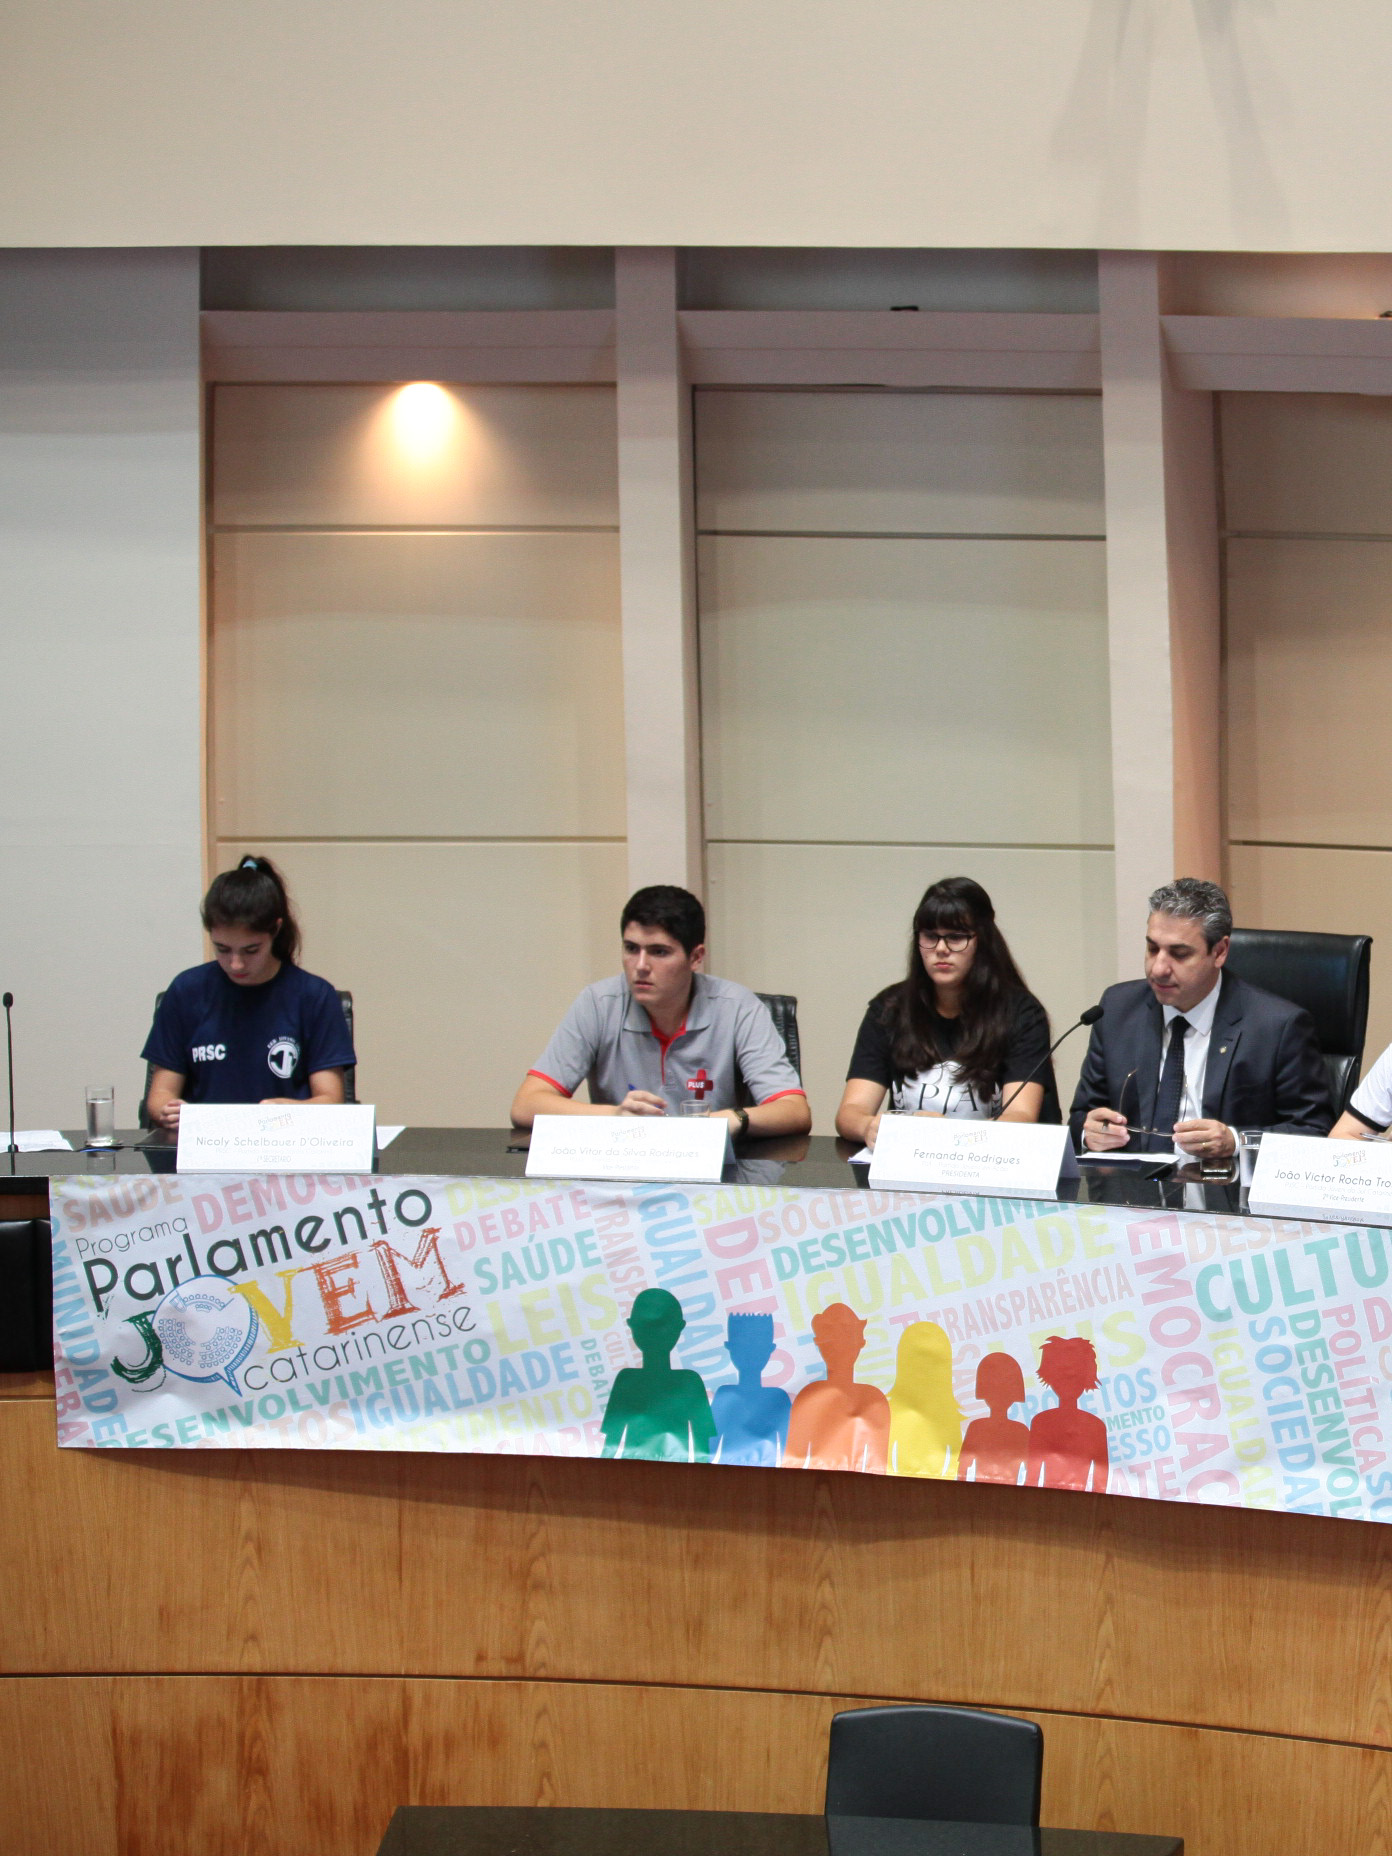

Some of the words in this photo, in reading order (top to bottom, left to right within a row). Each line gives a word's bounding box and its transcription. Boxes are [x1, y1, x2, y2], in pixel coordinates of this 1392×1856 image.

[192, 1044, 227, 1063] PRSC
[687, 1081, 705, 1089] PLUS
[196, 1136, 230, 1148] Nicoly
[233, 1136, 297, 1148] Schelbauer
[551, 1146, 577, 1156] João
[579, 1146, 602, 1156] Vitor
[605, 1147, 620, 1157] da
[623, 1147, 647, 1157] Silva
[649, 1148, 700, 1160] Rodrigues
[913, 1149, 964, 1161] Fernanda
[967, 1152, 1021, 1165] Rodrigues
[191, 1173, 406, 1234] DEMOC
[1275, 1169, 1301, 1181] João
[1304, 1171, 1335, 1183] Victor
[1338, 1174, 1372, 1187] Rocha
[76, 1217, 189, 1260] Programa
[83, 1188, 432, 1313] Parlamento
[453, 1189, 592, 1251] DEBATE
[473, 1228, 603, 1295] SAÚDE
[782, 1206, 1115, 1332] IGUALDADE
[111, 1227, 467, 1397] JOVEM
[485, 1273, 619, 1356] LEIS
[244, 1306, 477, 1391] catarinense
[1126, 1208, 1242, 1507] EMOCRAC
[349, 1341, 580, 1434] IGUALDADE
[1289, 1309, 1365, 1521] DESENVOL
